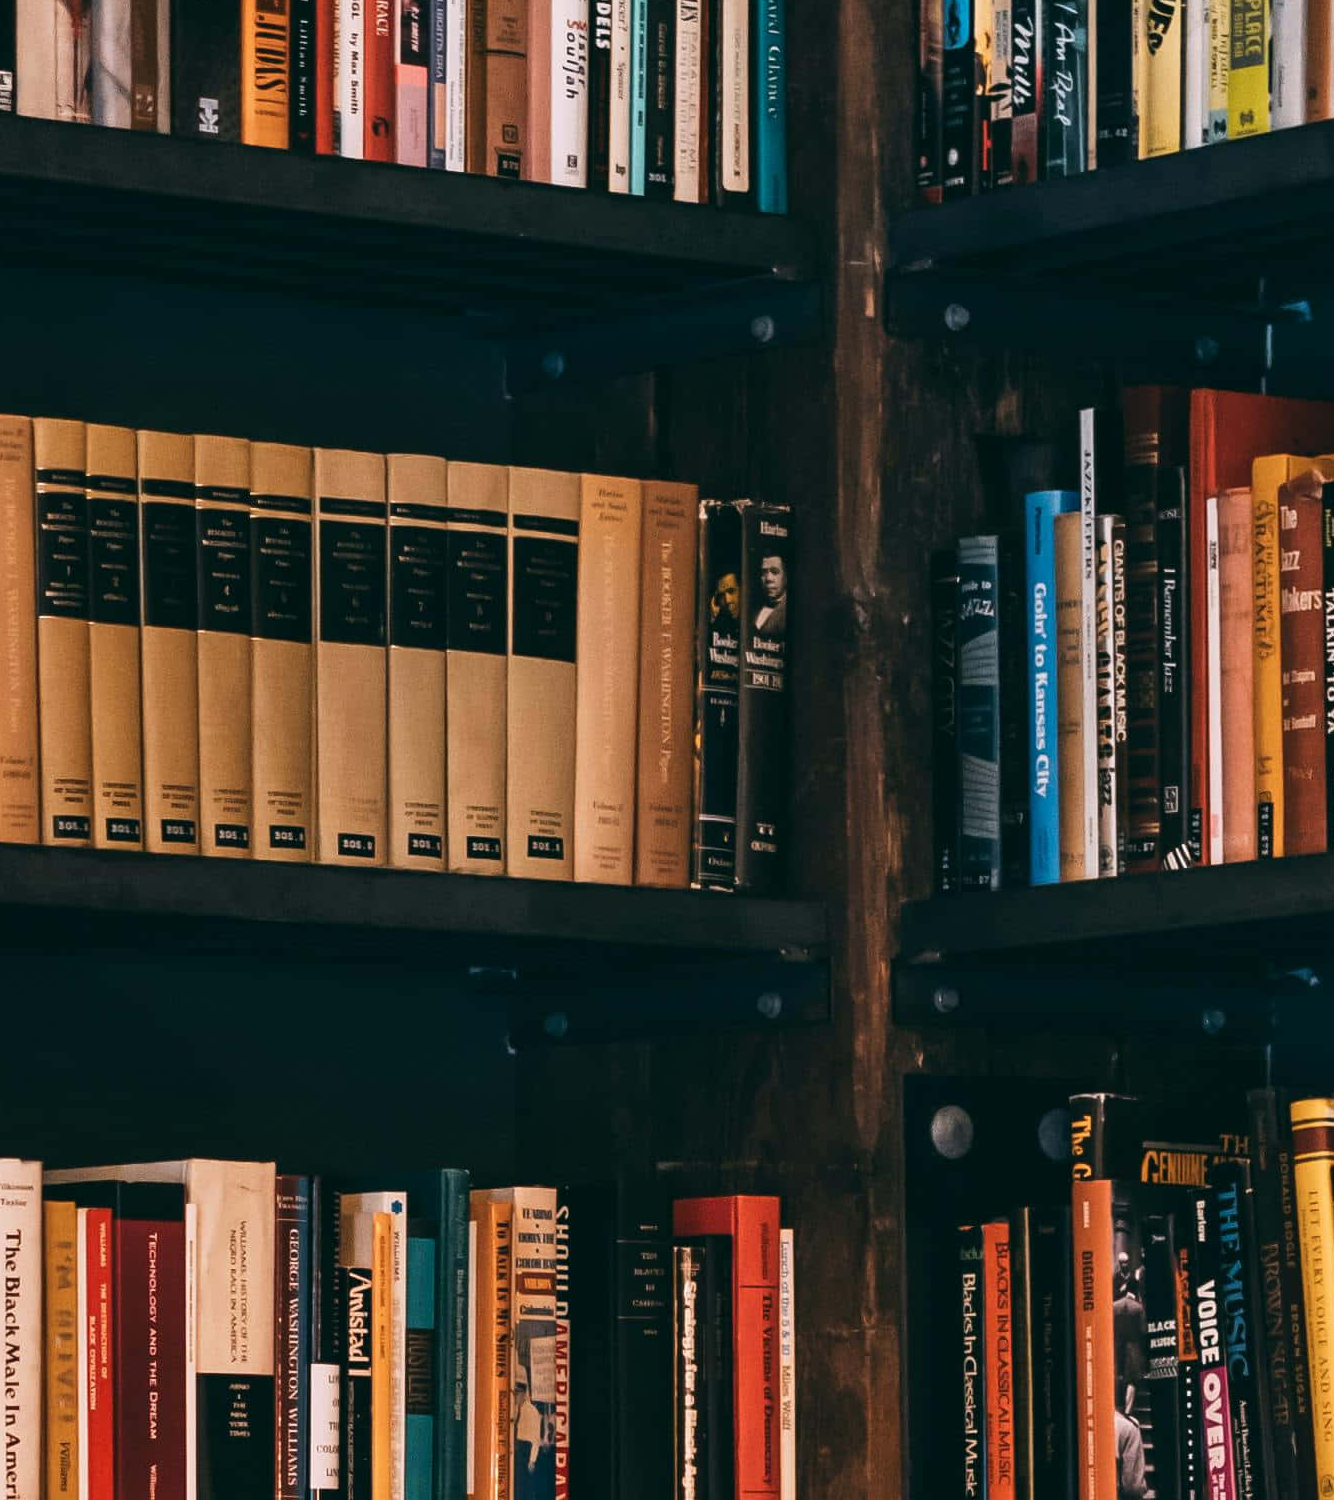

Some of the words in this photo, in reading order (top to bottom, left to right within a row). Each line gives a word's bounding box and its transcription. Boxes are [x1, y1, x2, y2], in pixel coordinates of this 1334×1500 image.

[376, 1, 391, 38] RACE
[4, 1230, 21, 1272] The
[286, 1229, 300, 1289] GEORGE
[4, 1276, 21, 1338] Black
[1196, 1280, 1220, 1366] VOICE
[4, 1341, 21, 1402] Male
[287, 1298, 300, 1401] WASHINGTON
[5, 1407, 21, 1428] In
[287, 1408, 300, 1486] WILLIAMS
[1203, 1372, 1225, 1472] OVER
